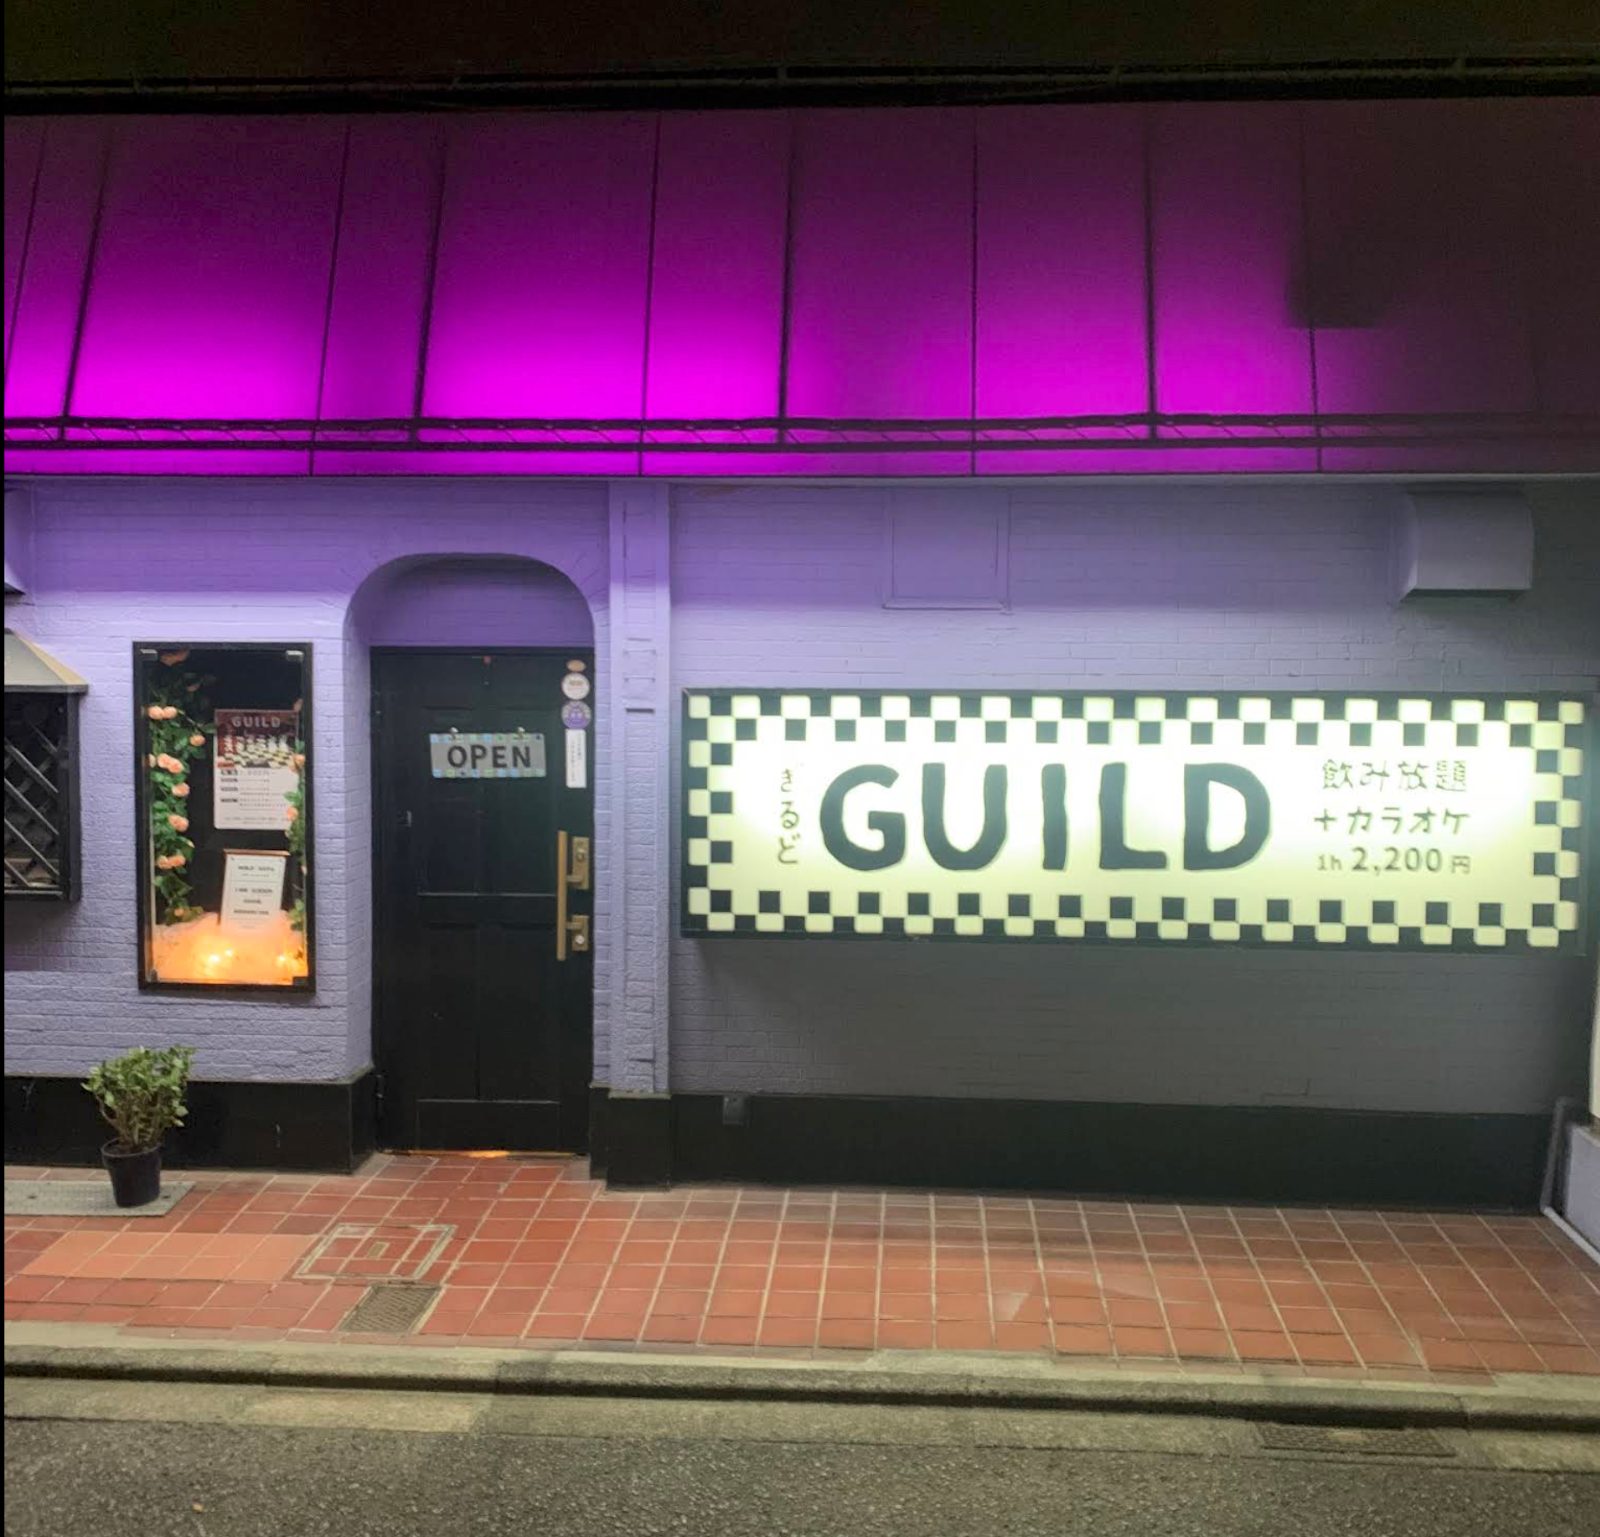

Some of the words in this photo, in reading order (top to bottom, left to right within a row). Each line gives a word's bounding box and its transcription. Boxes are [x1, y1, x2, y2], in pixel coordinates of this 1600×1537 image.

[231, 716, 281, 728] GUILD
[447, 744, 531, 769] OPEN
[1322, 758, 1467, 792] 飲み放題
[819, 763, 1271, 872] GUILD
[1317, 854, 1343, 871] 1h
